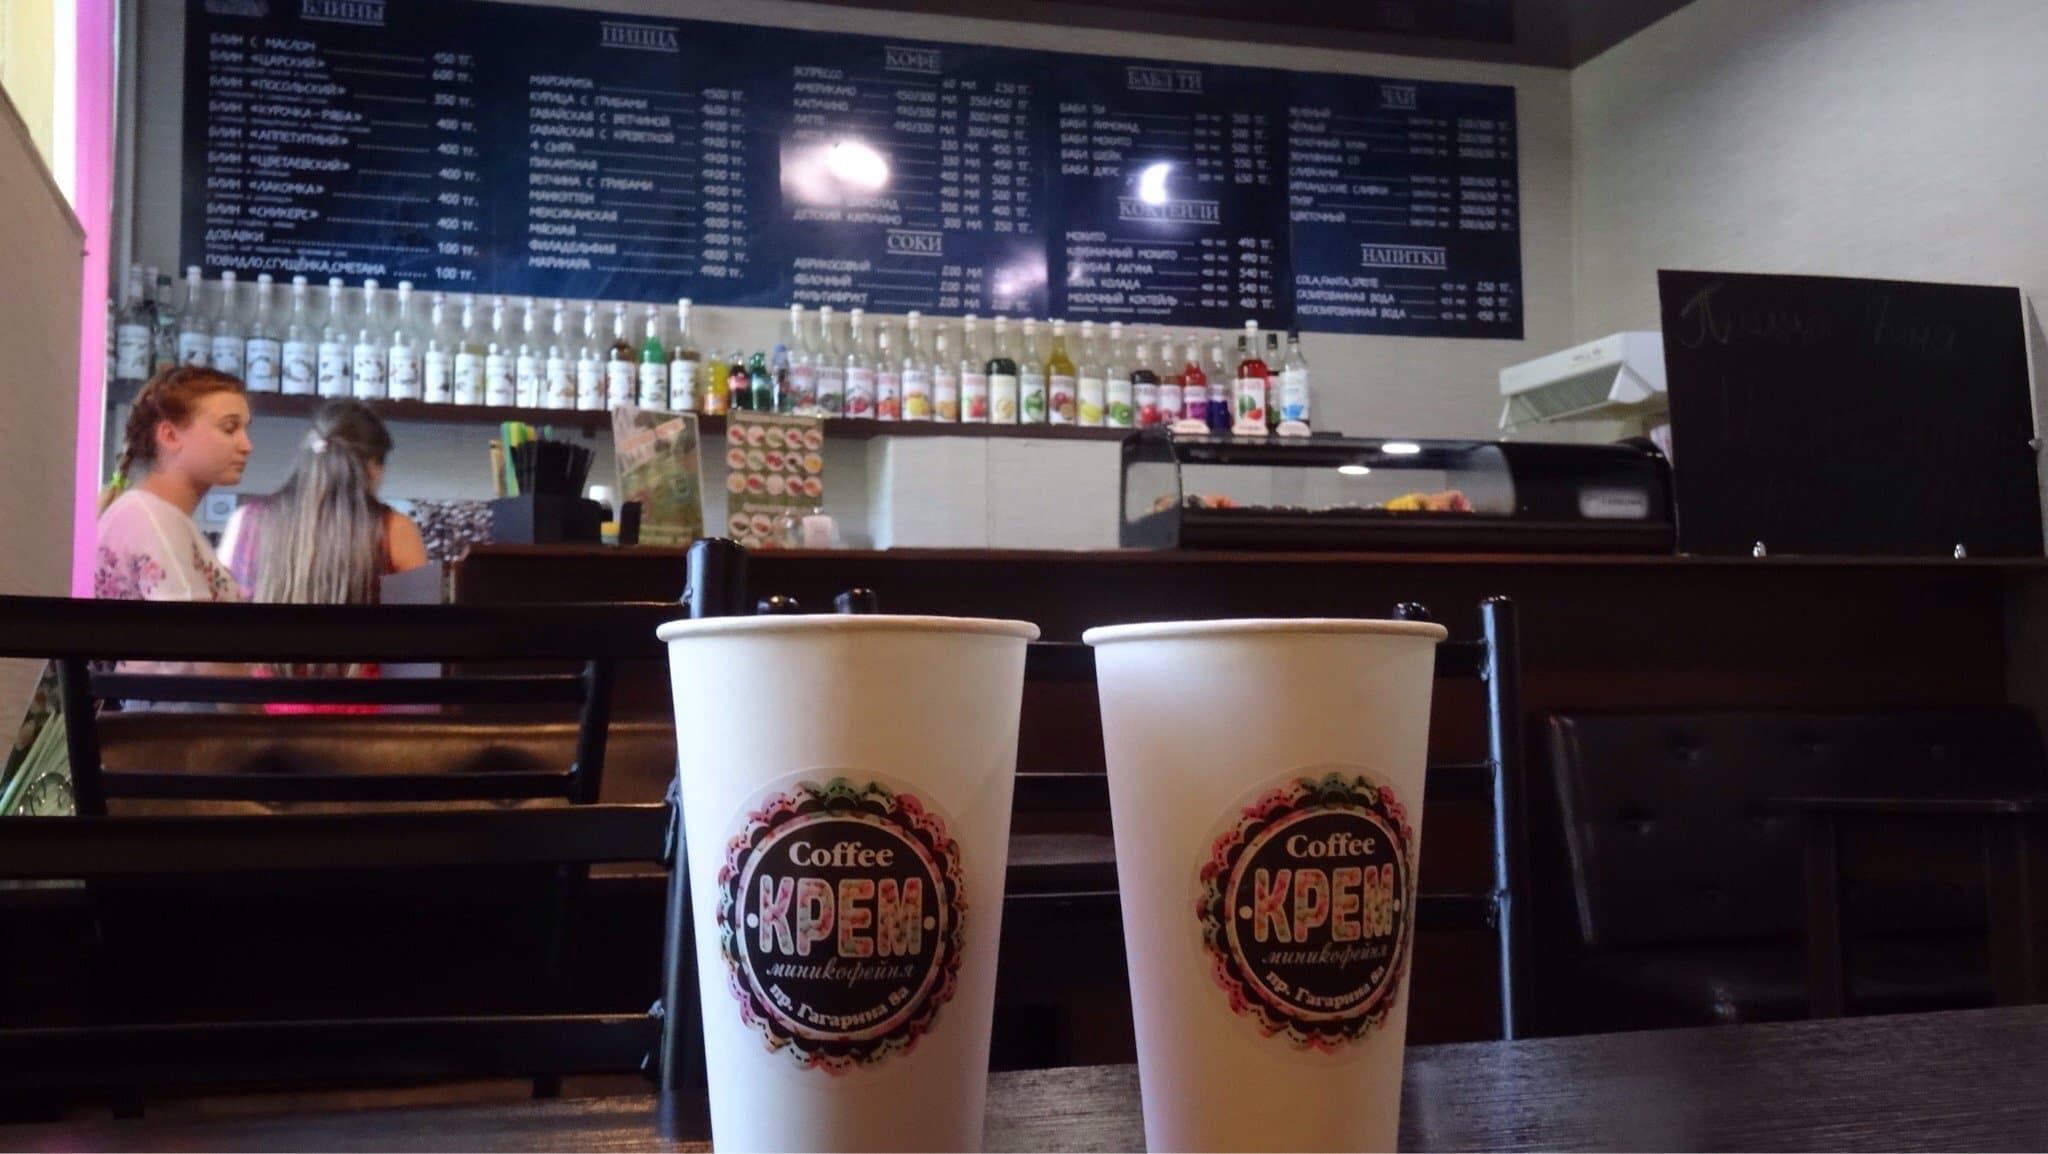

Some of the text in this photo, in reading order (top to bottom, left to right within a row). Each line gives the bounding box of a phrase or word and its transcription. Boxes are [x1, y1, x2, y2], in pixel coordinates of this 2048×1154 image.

[209, 32, 243, 46] БЛИН
[265, 37, 317, 52] МАСЛОМ
[602, 26, 679, 49] ПИЦЦА
[209, 49, 243, 62] БЛИН
[886, 51, 943, 71] КОФЕ
[208, 75, 243, 88] БЛИН
[208, 100, 243, 113] БЛИН
[208, 125, 242, 139] БЛИН
[207, 151, 242, 164] БЛИН
[207, 176, 241, 190] БЛИН
[206, 201, 241, 215] БЛИН
[205, 228, 265, 243] ДОБАВКИ
[886, 234, 943, 251] СОКИ
[1361, 248, 1447, 266] НАПИТКИ
[435, 266, 459, 280] 100
[789, 840, 894, 867] Coffee
[1286, 833, 1376, 858] Coffee
[1254, 863, 1394, 943] КРЕМ
[758, 874, 923, 958] КРЕМ
[766, 956, 915, 989] миникофейня
[1265, 970, 1291, 996] пр.
[1295, 982, 1371, 1010] Гагарина
[769, 983, 794, 1011] пр.
[797, 1002, 888, 1029] Гагарина
